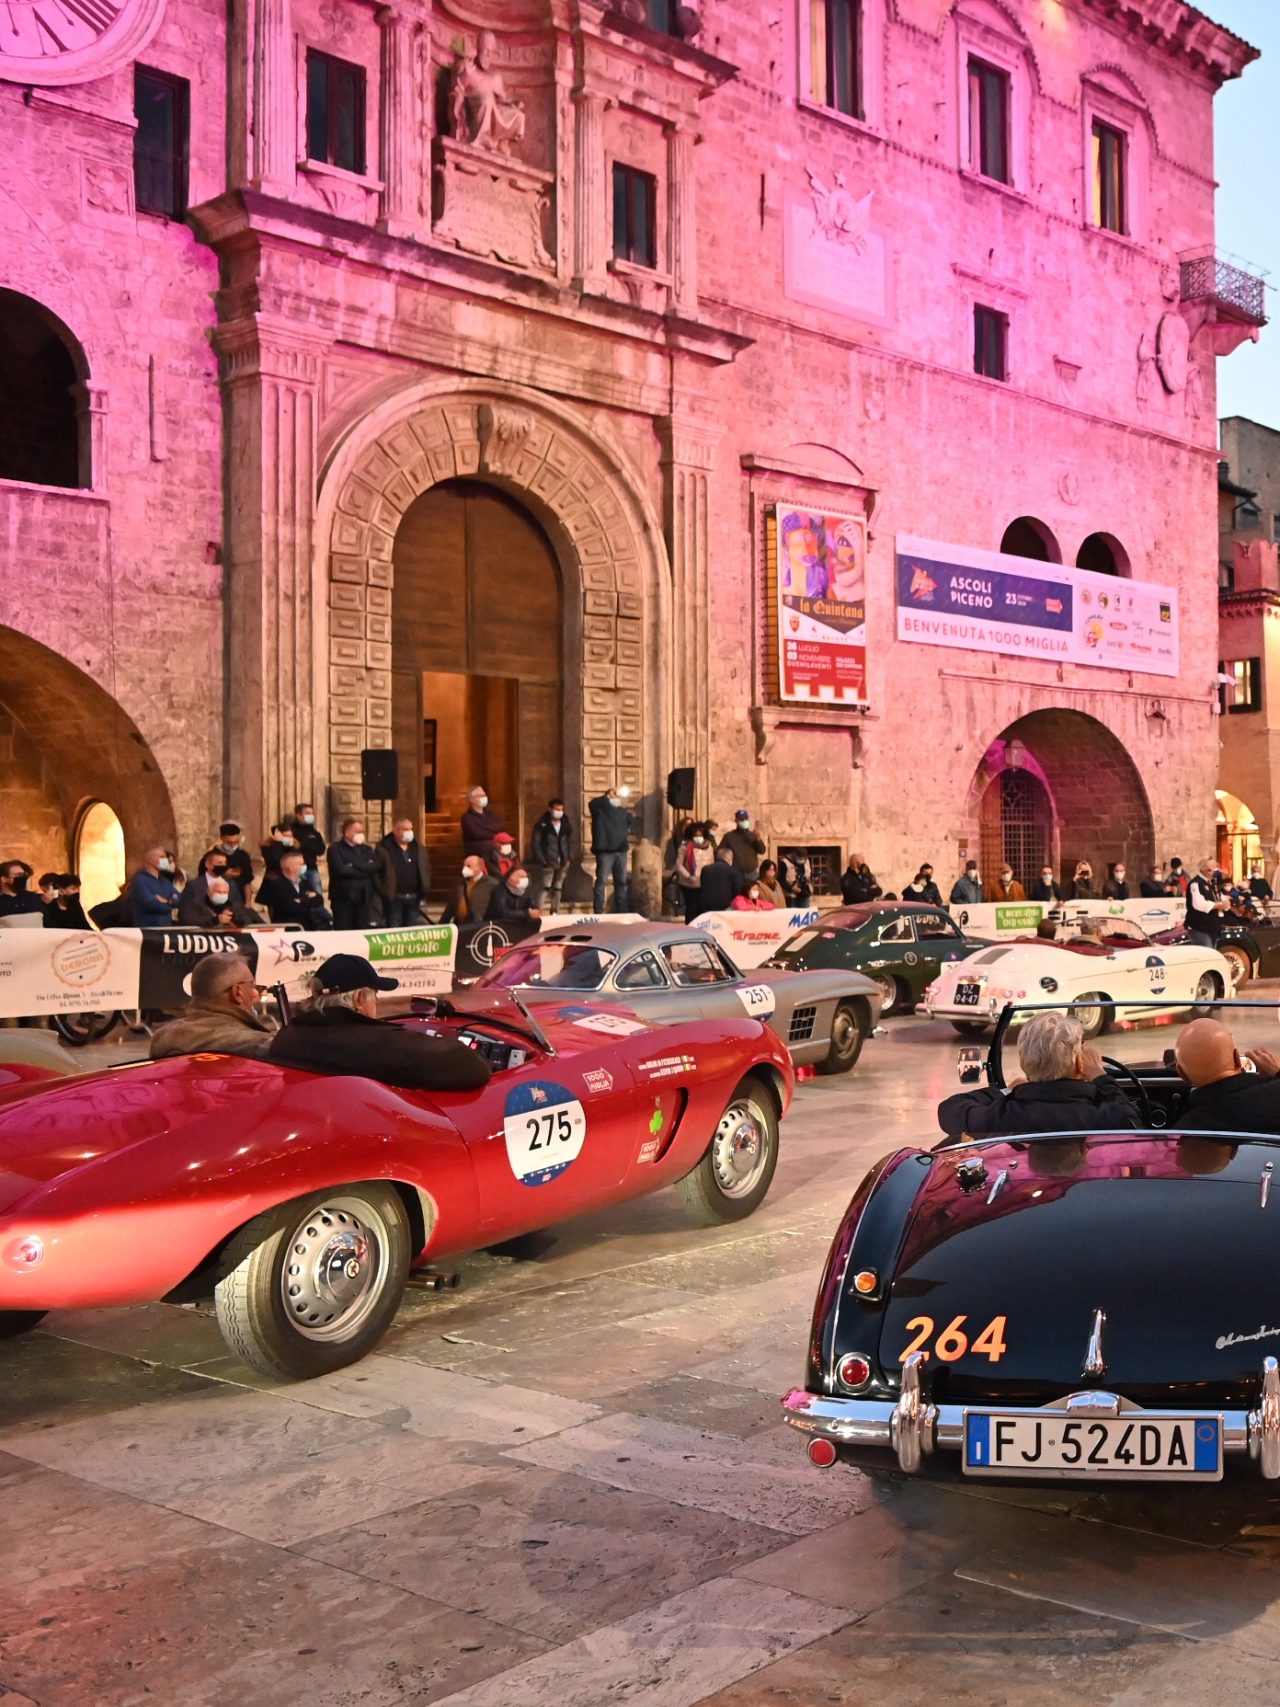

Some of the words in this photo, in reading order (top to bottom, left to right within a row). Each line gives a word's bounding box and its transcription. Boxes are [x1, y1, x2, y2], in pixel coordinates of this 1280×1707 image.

[950, 575, 992, 593] ASCOLI
[950, 591, 993, 609] PICENO
[1005, 592, 1018, 605] 23
[813, 600, 864, 619] Quintana
[904, 617, 986, 641] BENVENUTA
[989, 630, 1021, 647] 1000
[1025, 637, 1069, 652] MIGLIA
[798, 645, 819, 653] LUGLIO
[786, 659, 832, 670] DUEMILAVENTI
[163, 933, 239, 954] LUDUS
[386, 929, 449, 943] MERCATINO
[729, 929, 783, 942] Faraone
[1149, 967, 1165, 982] 248
[745, 987, 769, 1004] 251
[962, 984, 975, 994] DZ
[586, 1072, 605, 1082] 1000
[590, 1080, 610, 1091] MIGLIA
[526, 1110, 573, 1151] 275
[899, 1315, 1008, 1363] 264
[994, 1420, 1043, 1463] FJ
[1060, 1422, 1189, 1466] 524DA
